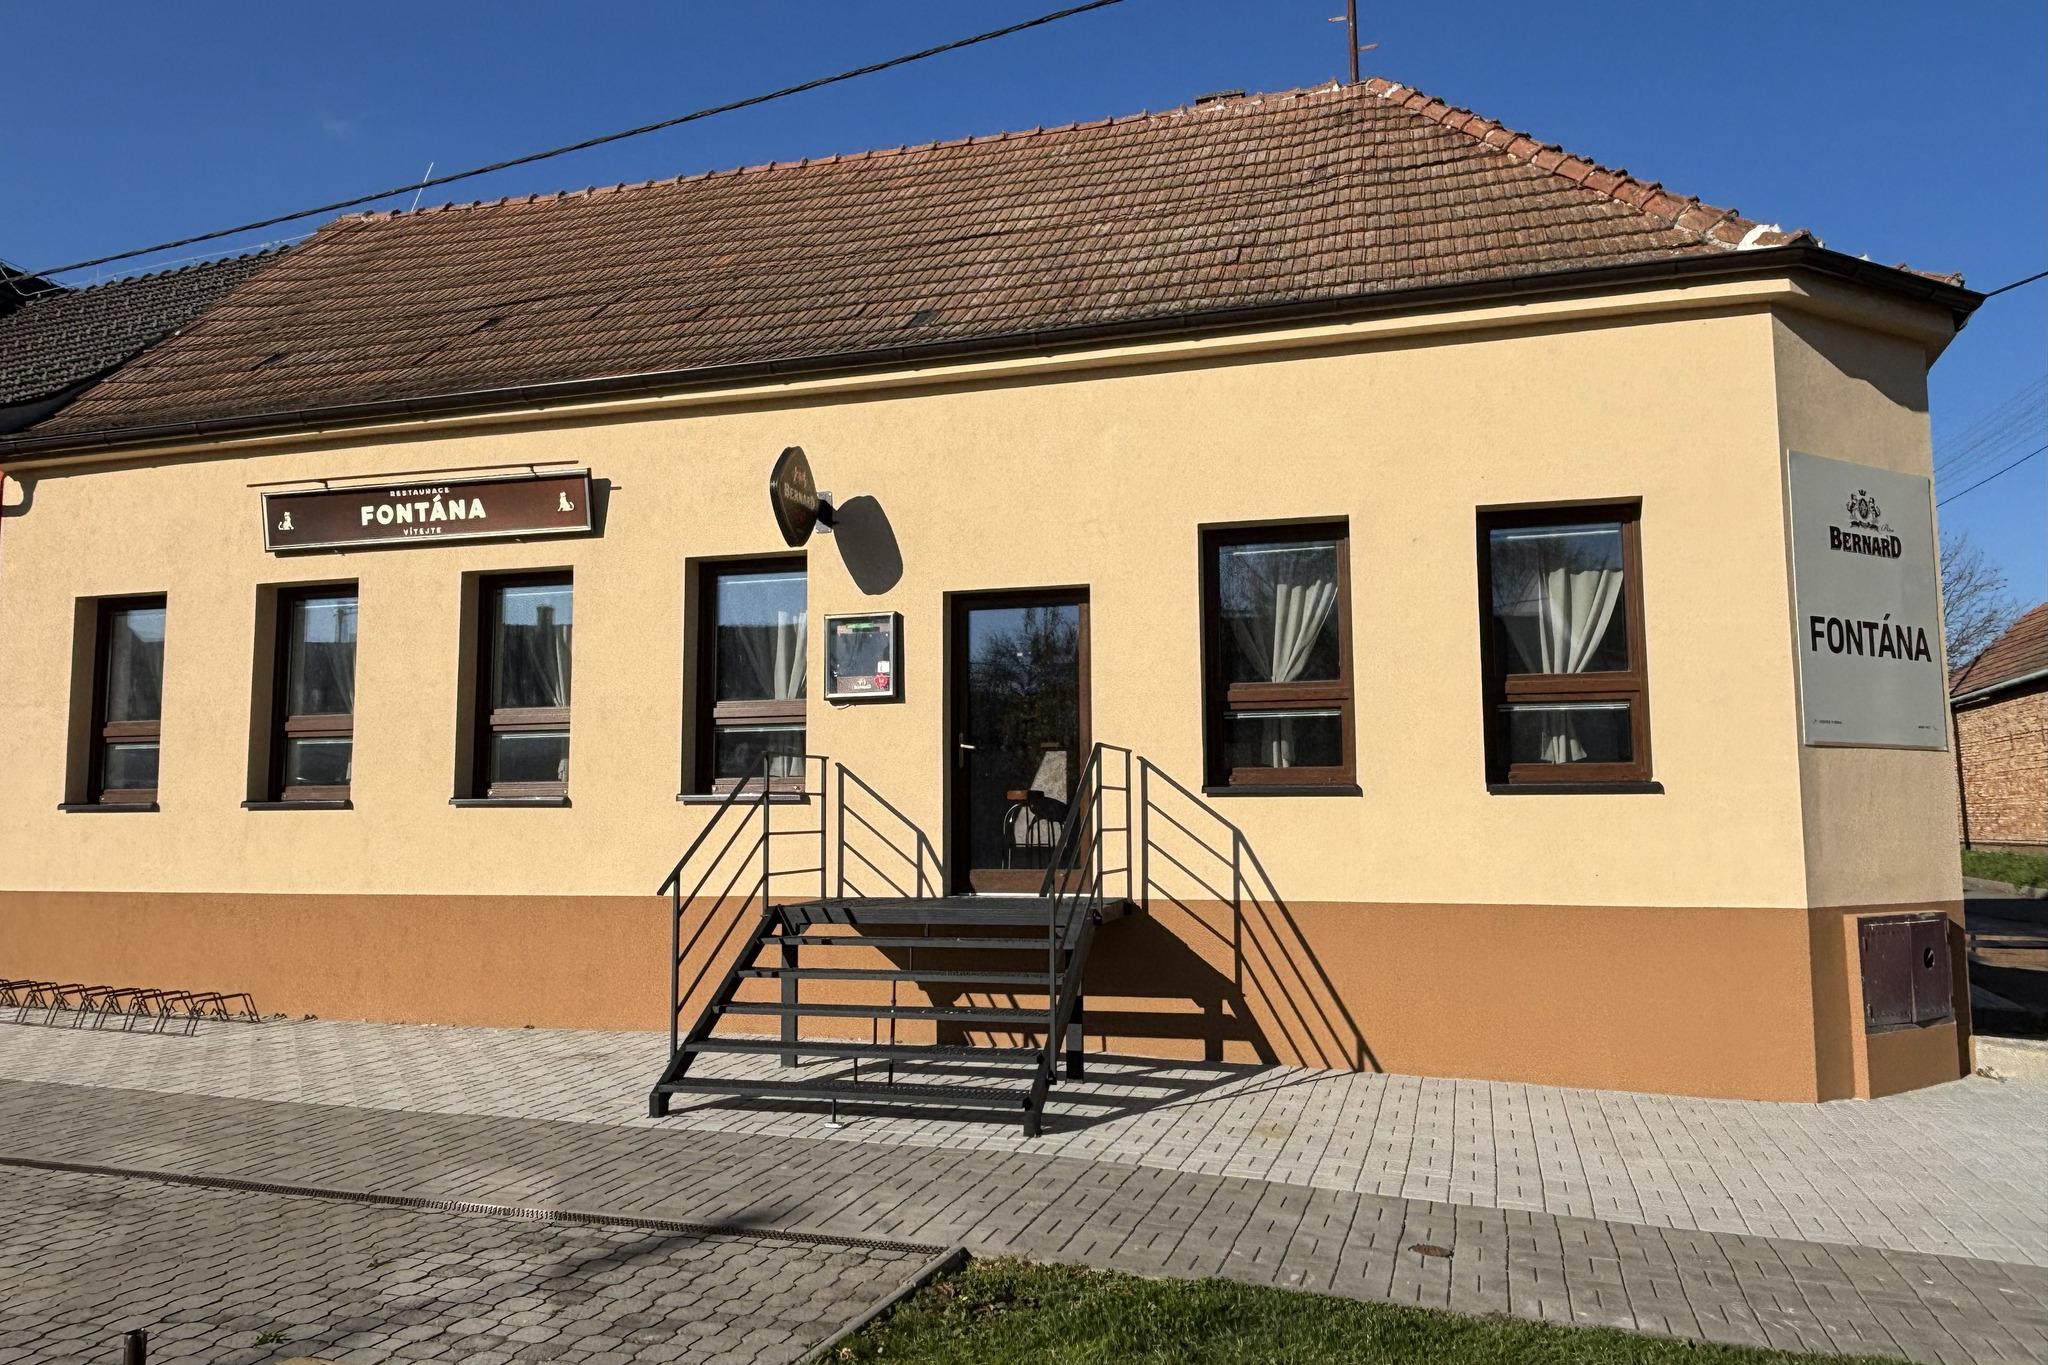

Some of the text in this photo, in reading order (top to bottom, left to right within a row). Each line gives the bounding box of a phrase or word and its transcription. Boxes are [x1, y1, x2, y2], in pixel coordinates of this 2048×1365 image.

[390, 487, 450, 497] RESTAURACE
[361, 494, 487, 526] FONTÁNA
[403, 527, 442, 536] VÍTEJTE
[1829, 525, 1902, 559] BERNARD
[1810, 613, 1932, 662] FONTÁNA
